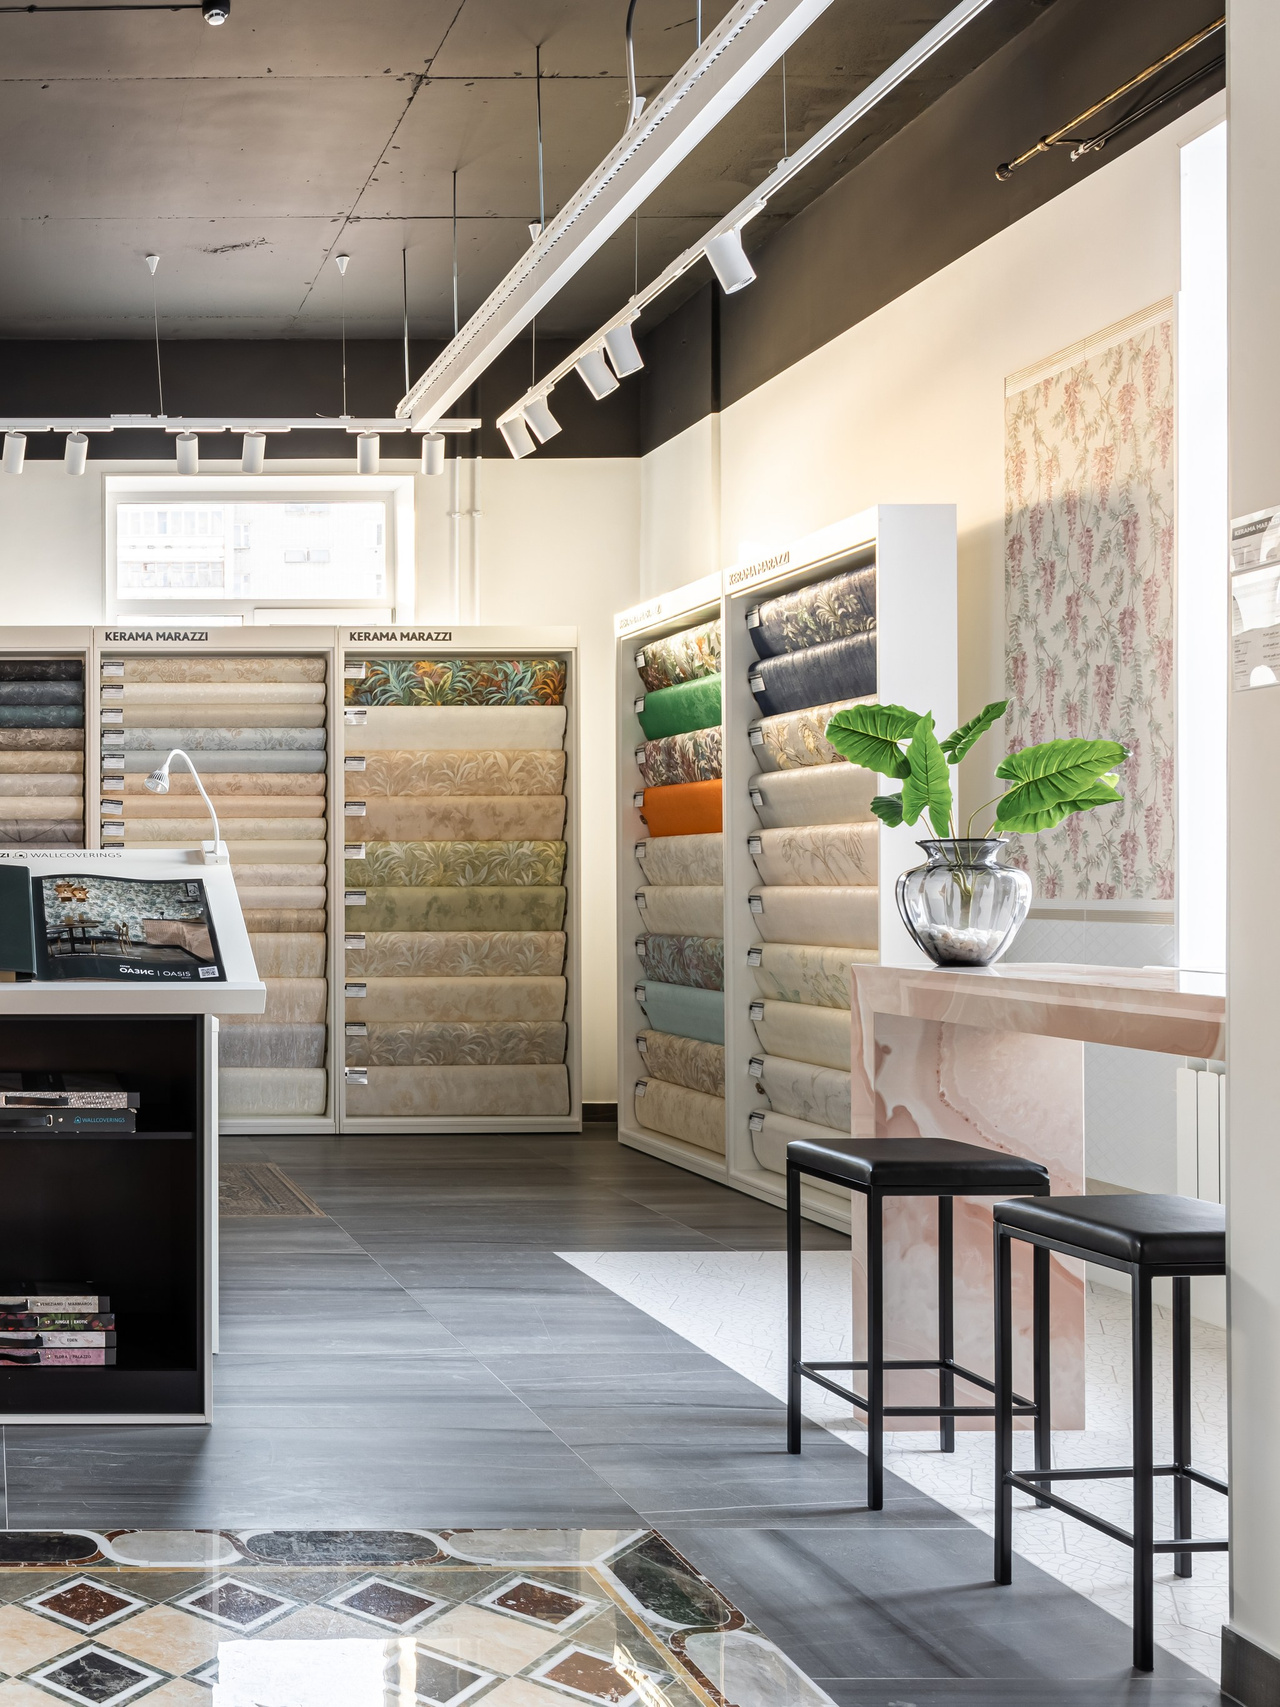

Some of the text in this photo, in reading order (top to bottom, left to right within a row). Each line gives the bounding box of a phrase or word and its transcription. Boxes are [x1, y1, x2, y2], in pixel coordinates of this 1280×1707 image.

[728, 551, 790, 586] KERAMA MARAZZI
[105, 632, 208, 642] KERAMA MARAZZI
[350, 632, 452, 642] KERAMA MARAZZI
[119, 966, 155, 976] ОАЗИС
[163, 970, 191, 978] OASIS
[82, 1116, 126, 1124] WALLCOVERINGS
